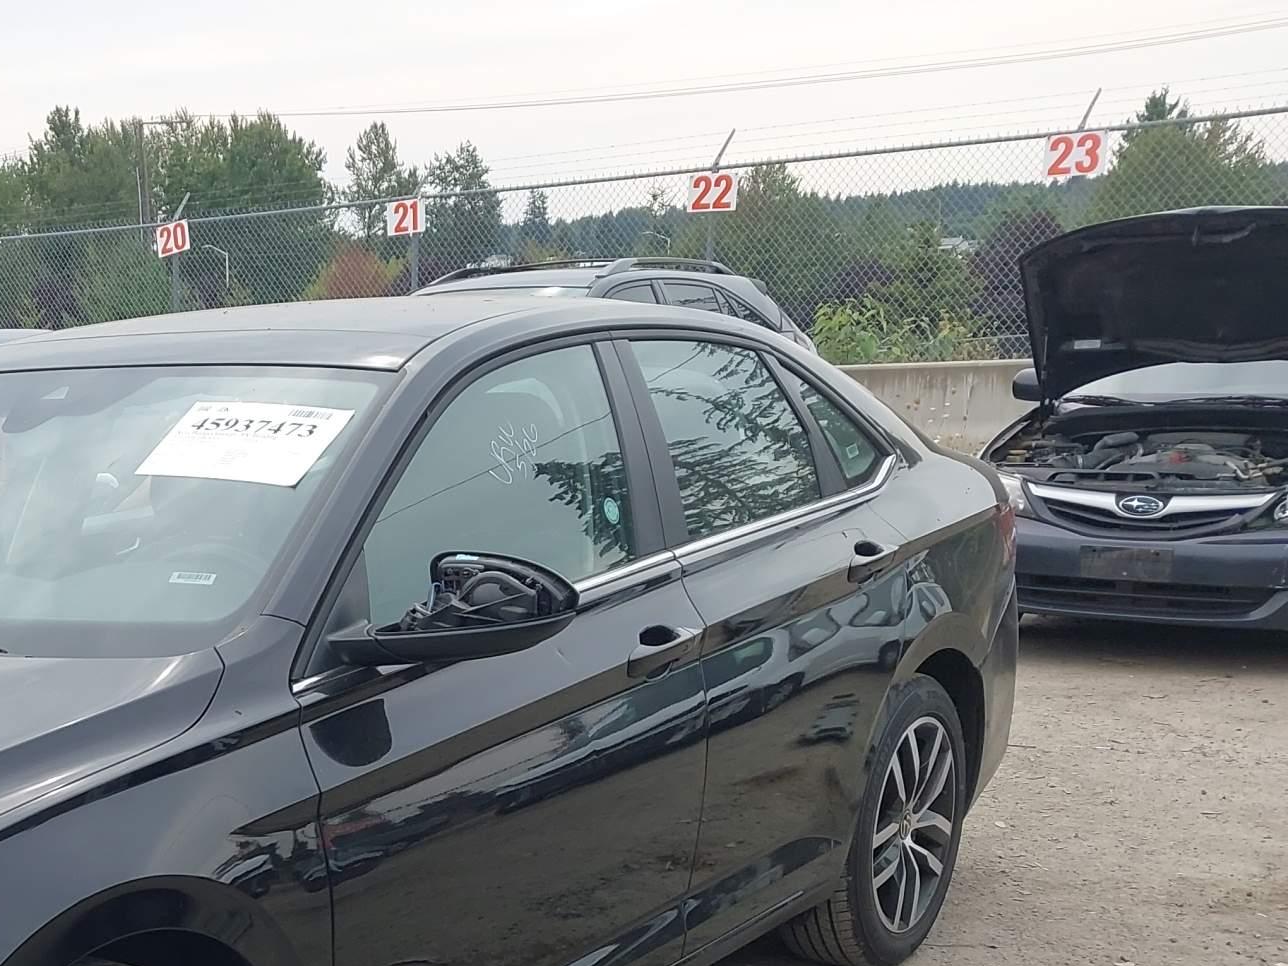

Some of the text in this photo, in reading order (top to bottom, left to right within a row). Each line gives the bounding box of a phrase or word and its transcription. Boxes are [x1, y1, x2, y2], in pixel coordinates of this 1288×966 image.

[1047, 133, 1101, 176] 23
[692, 174, 733, 210] 22
[393, 200, 418, 233] 21
[159, 222, 187, 254] 20
[191, 412, 318, 438] 45937473
